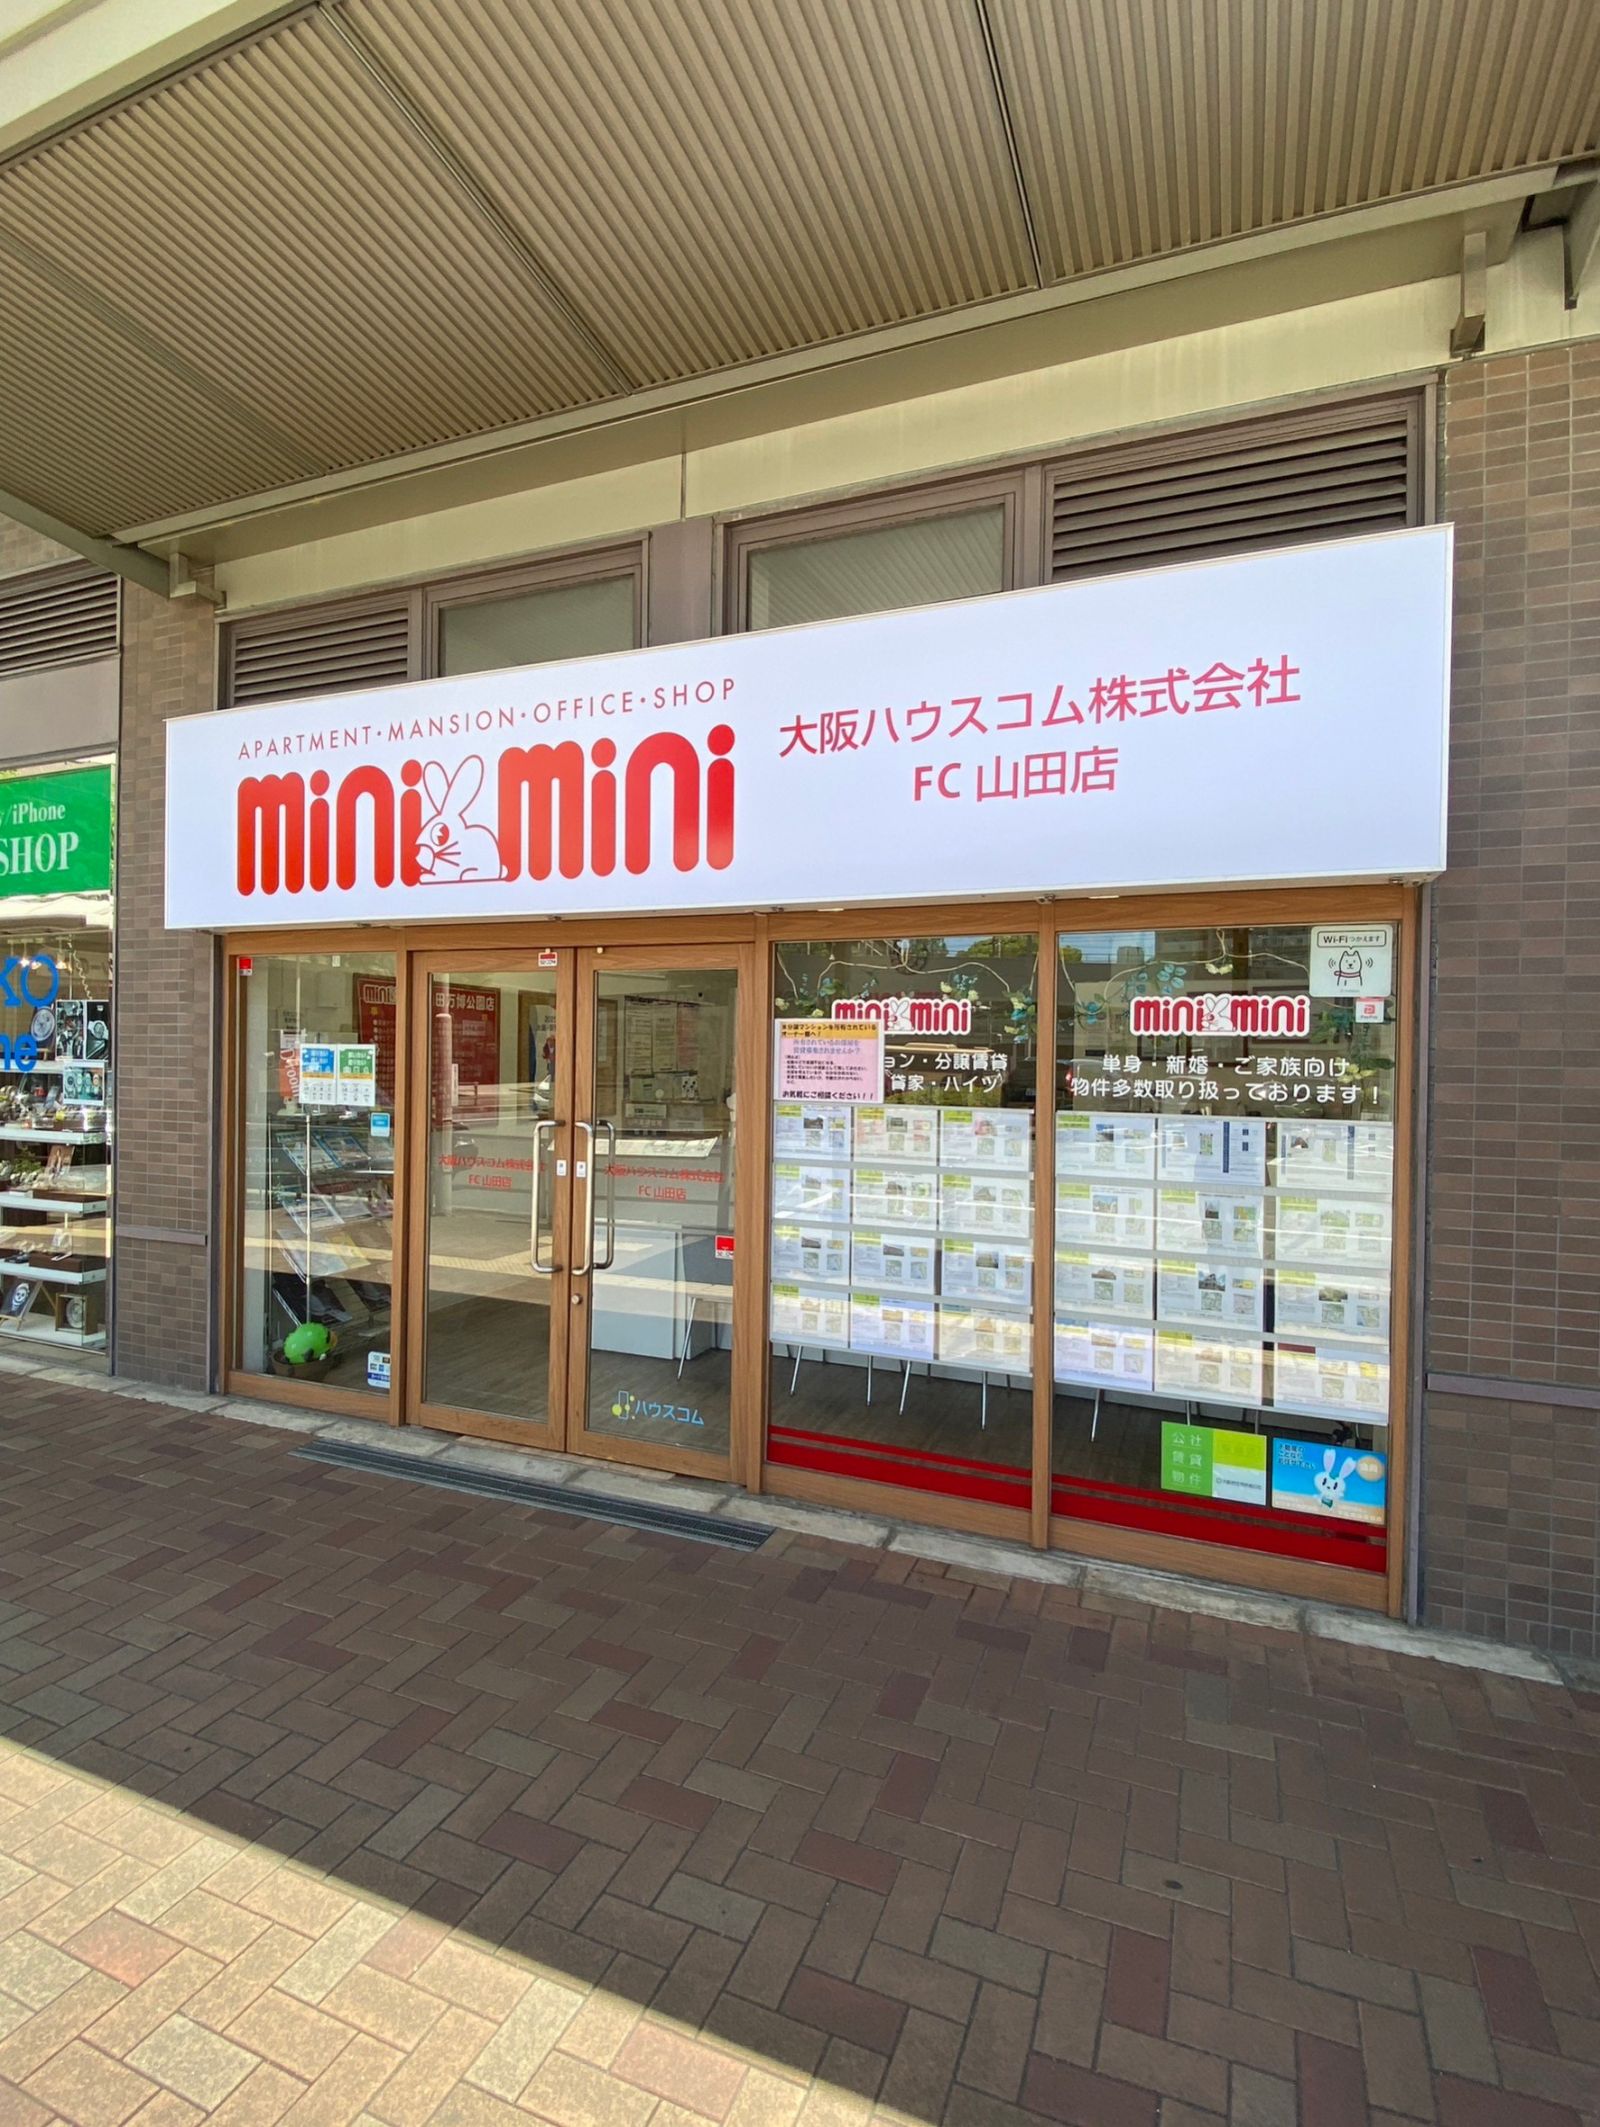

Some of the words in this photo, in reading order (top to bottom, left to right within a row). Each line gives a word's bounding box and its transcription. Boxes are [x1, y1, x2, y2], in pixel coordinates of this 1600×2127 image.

[778, 655, 1300, 759] 大阪ハウスコム株式会社
[912, 762, 961, 802] FC
[976, 746, 1119, 802] 山田店
[237, 759, 423, 897] mini
[497, 723, 735, 882] mini
[910, 1001, 969, 1031] mini
[1133, 998, 1205, 1032] mini
[1231, 998, 1305, 1032] mini
[635, 1399, 705, 1427] ハウスコム
